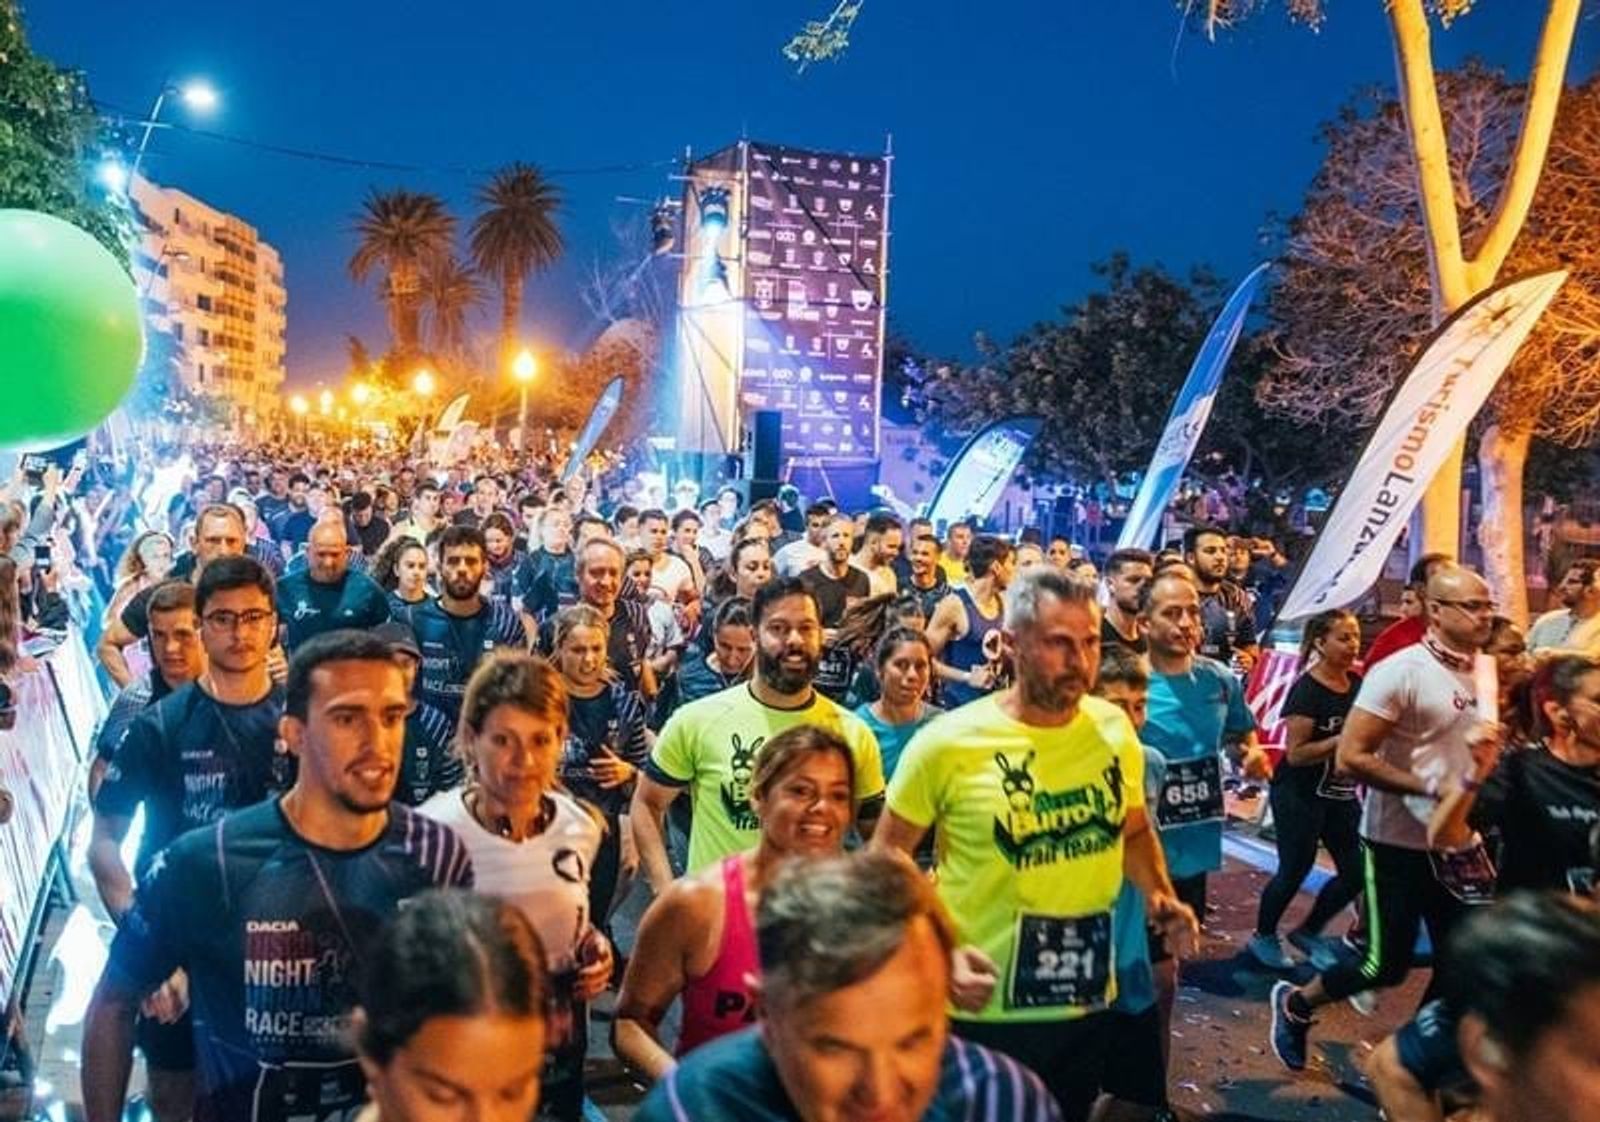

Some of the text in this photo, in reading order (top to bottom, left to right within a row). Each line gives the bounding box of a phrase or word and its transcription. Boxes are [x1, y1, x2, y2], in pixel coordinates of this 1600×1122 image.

[1315, 357, 1474, 605] TurismoLanz
[1165, 781, 1210, 806] 658
[246, 919, 299, 932] DACIA
[244, 957, 318, 987] NIGHT
[1034, 948, 1095, 981] 221
[244, 1007, 303, 1036] RACE
